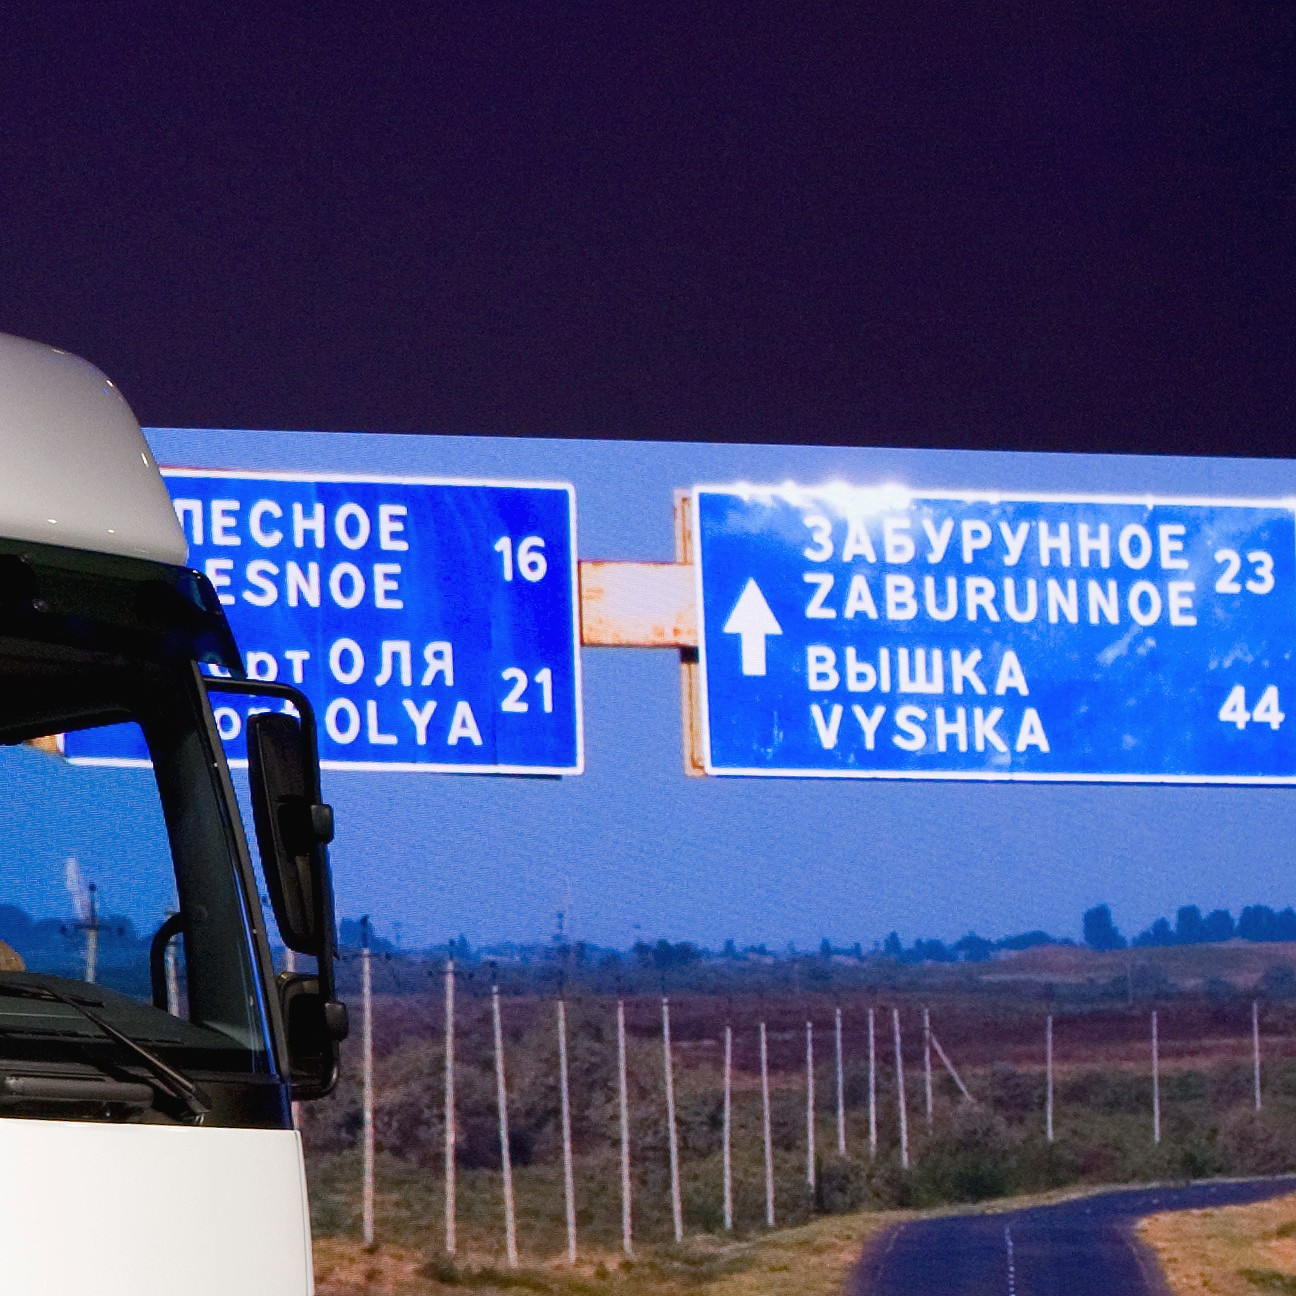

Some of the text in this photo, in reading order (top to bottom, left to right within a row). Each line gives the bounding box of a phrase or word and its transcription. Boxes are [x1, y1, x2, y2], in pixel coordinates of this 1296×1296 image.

[494, 536, 548, 582] 16
[802, 515, 1190, 570] ЗАБУРУННОЕ
[205, 558, 405, 609] ESNOE
[1214, 550, 1276, 595] 23
[802, 572, 1198, 627] ZABURUNNOE
[329, 637, 454, 687] ОЛЯ
[808, 645, 1029, 697] ВЫШКА
[501, 668, 554, 713] 21
[1218, 684, 1286, 731] 44
[325, 697, 483, 746] OLYA
[811, 702, 1051, 753] VYSHKA
